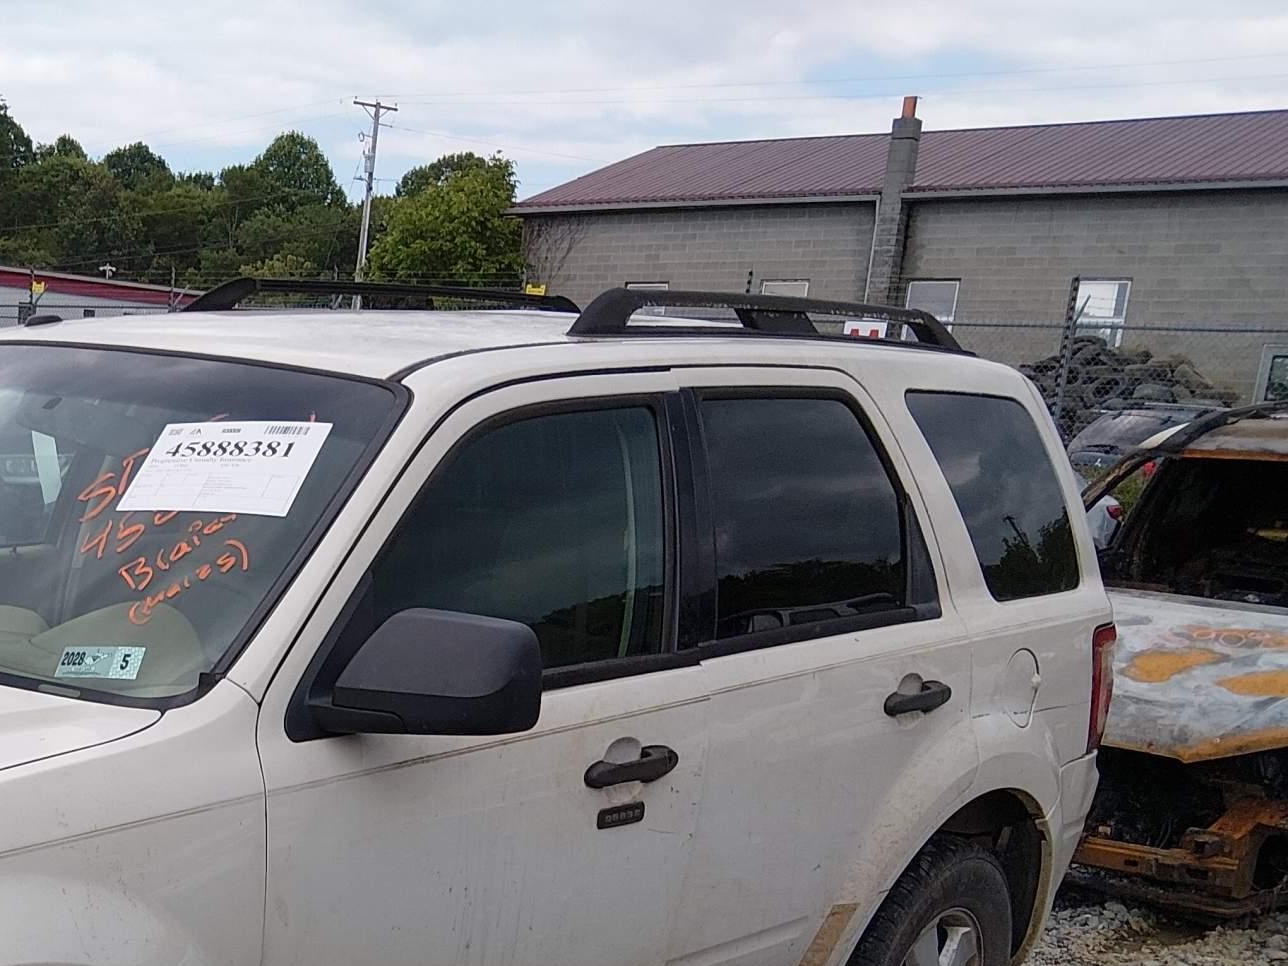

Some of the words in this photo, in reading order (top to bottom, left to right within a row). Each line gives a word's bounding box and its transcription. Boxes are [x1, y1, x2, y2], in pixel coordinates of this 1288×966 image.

[165, 440, 296, 458] 45888381
[61, 651, 86, 666] 2028
[119, 653, 131, 670] 5
